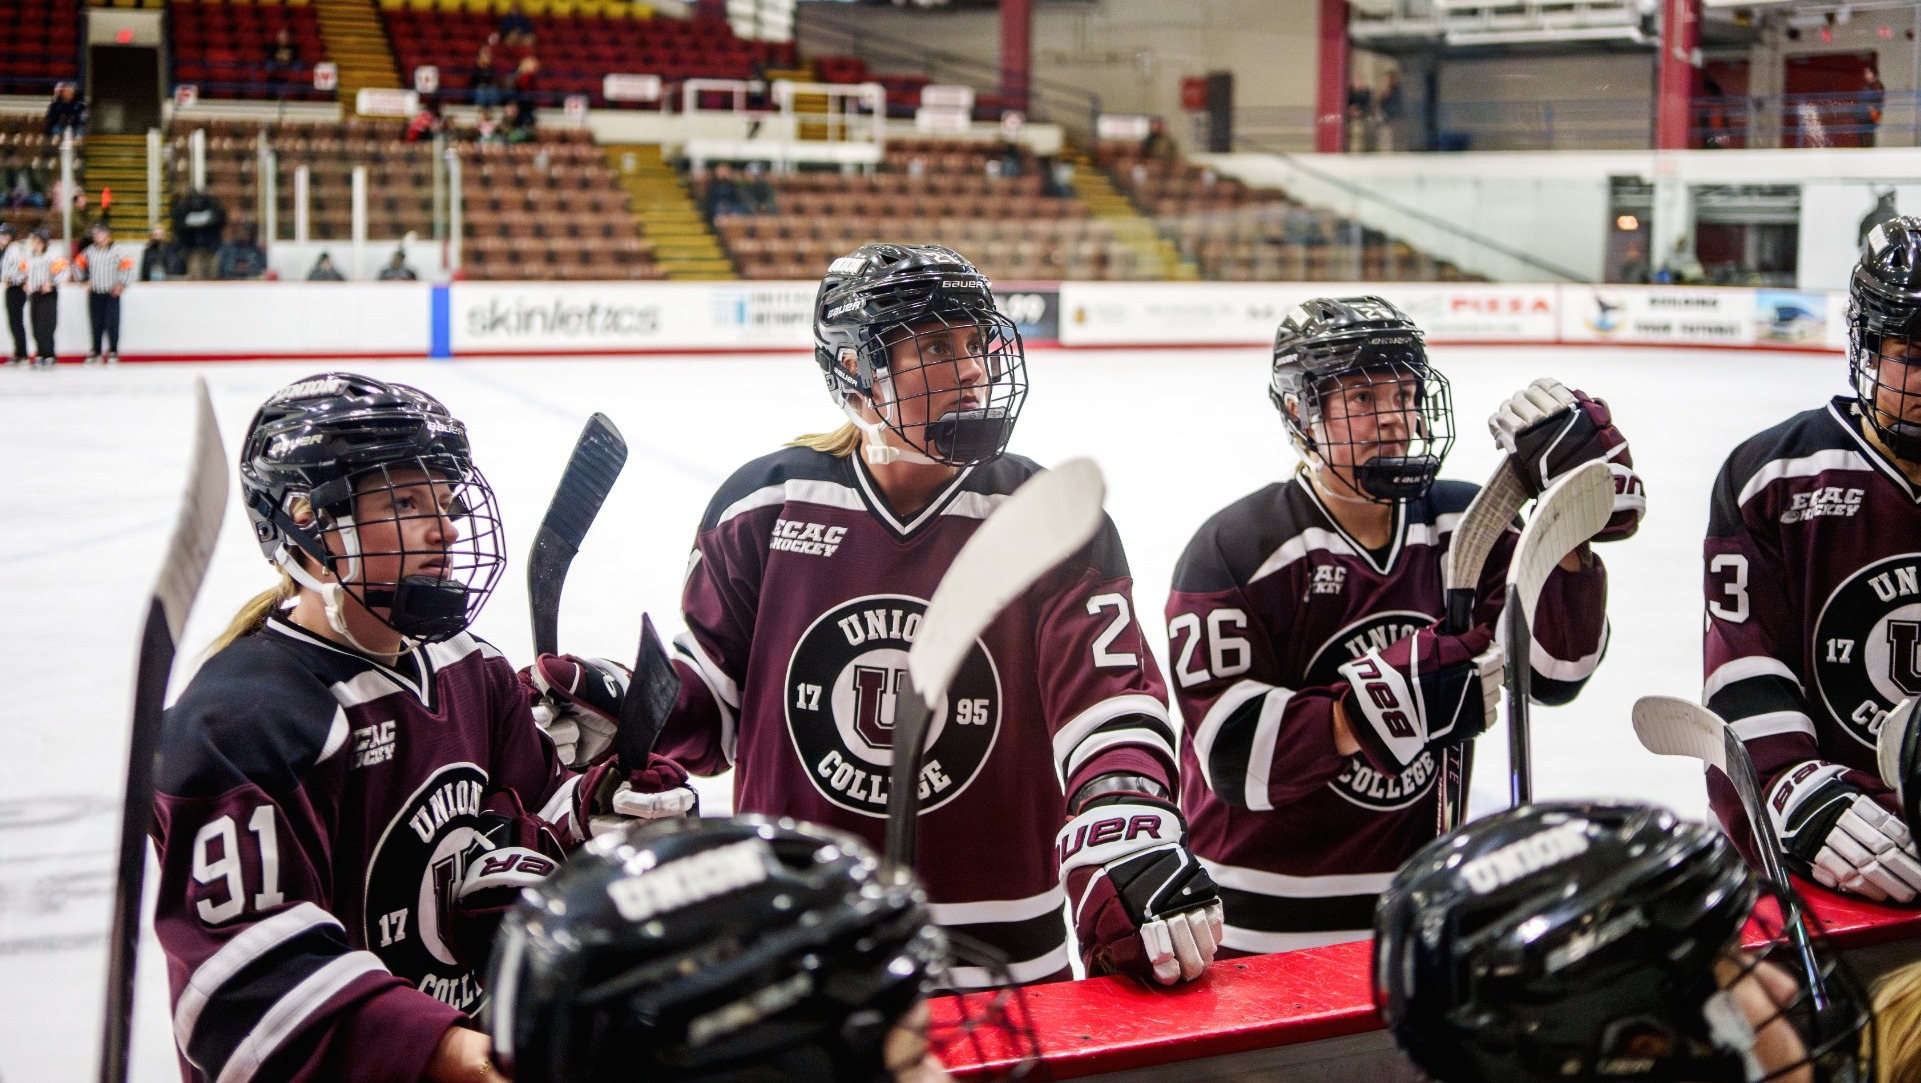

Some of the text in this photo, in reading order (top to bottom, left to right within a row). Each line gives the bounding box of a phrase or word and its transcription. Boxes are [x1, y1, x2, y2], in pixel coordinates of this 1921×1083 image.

[1791, 487, 1865, 511] ECAC
[771, 519, 848, 544] ECAC
[772, 537, 839, 557] HOCKEY
[1313, 565, 1347, 581] AC
[838, 609, 926, 646] UNIO
[1345, 624, 1415, 658] UNIO
[1169, 608, 1251, 688] 26
[1826, 638, 1854, 663] 17
[797, 683, 822, 711] 17
[956, 698, 989, 725] 95
[818, 750, 952, 804] COLLGE
[1057, 815, 1162, 866] UER
[193, 804, 285, 925] 91
[379, 908, 409, 947] 17
